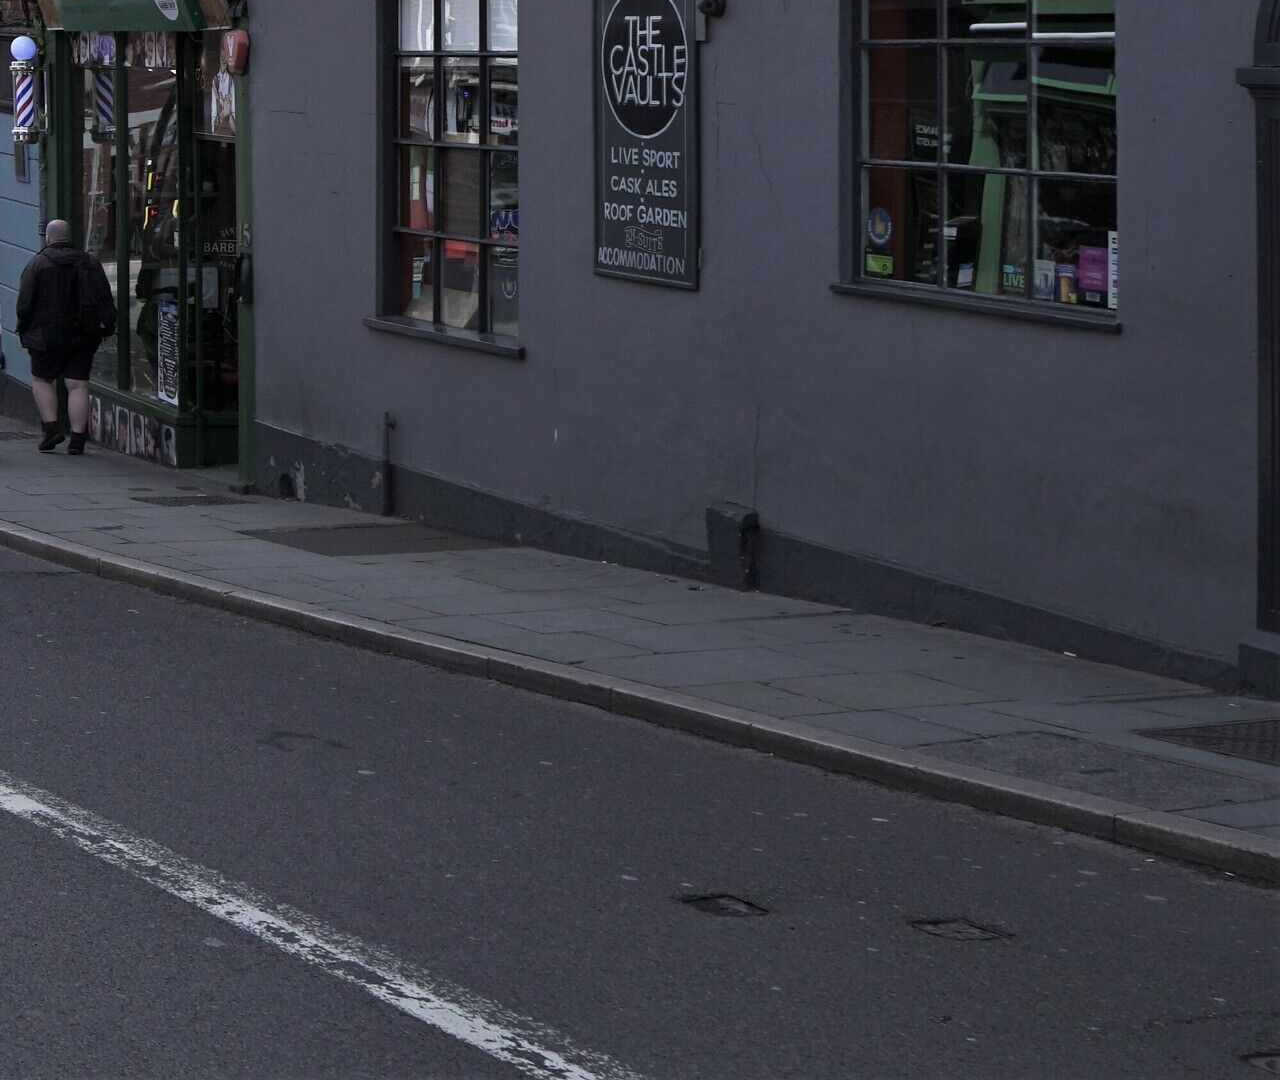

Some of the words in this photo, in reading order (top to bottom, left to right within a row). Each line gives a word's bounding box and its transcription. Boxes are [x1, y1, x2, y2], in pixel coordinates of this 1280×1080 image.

[624, 16, 662, 48] THE
[610, 45, 687, 77] CASTLE
[612, 72, 684, 107] VAULTS
[611, 147, 639, 165] LIVE
[642, 149, 680, 169] SPORT
[610, 176, 641, 194] CASK
[645, 179, 678, 197] ALES
[604, 202, 634, 221] ROOF
[637, 205, 687, 228] GARDEN
[204, 242, 237, 253] BARB
[625, 229, 663, 250] EN-SUITE
[598, 246, 685, 275] ACCOMMODATION
[1003, 273, 1025, 288] LIVE
